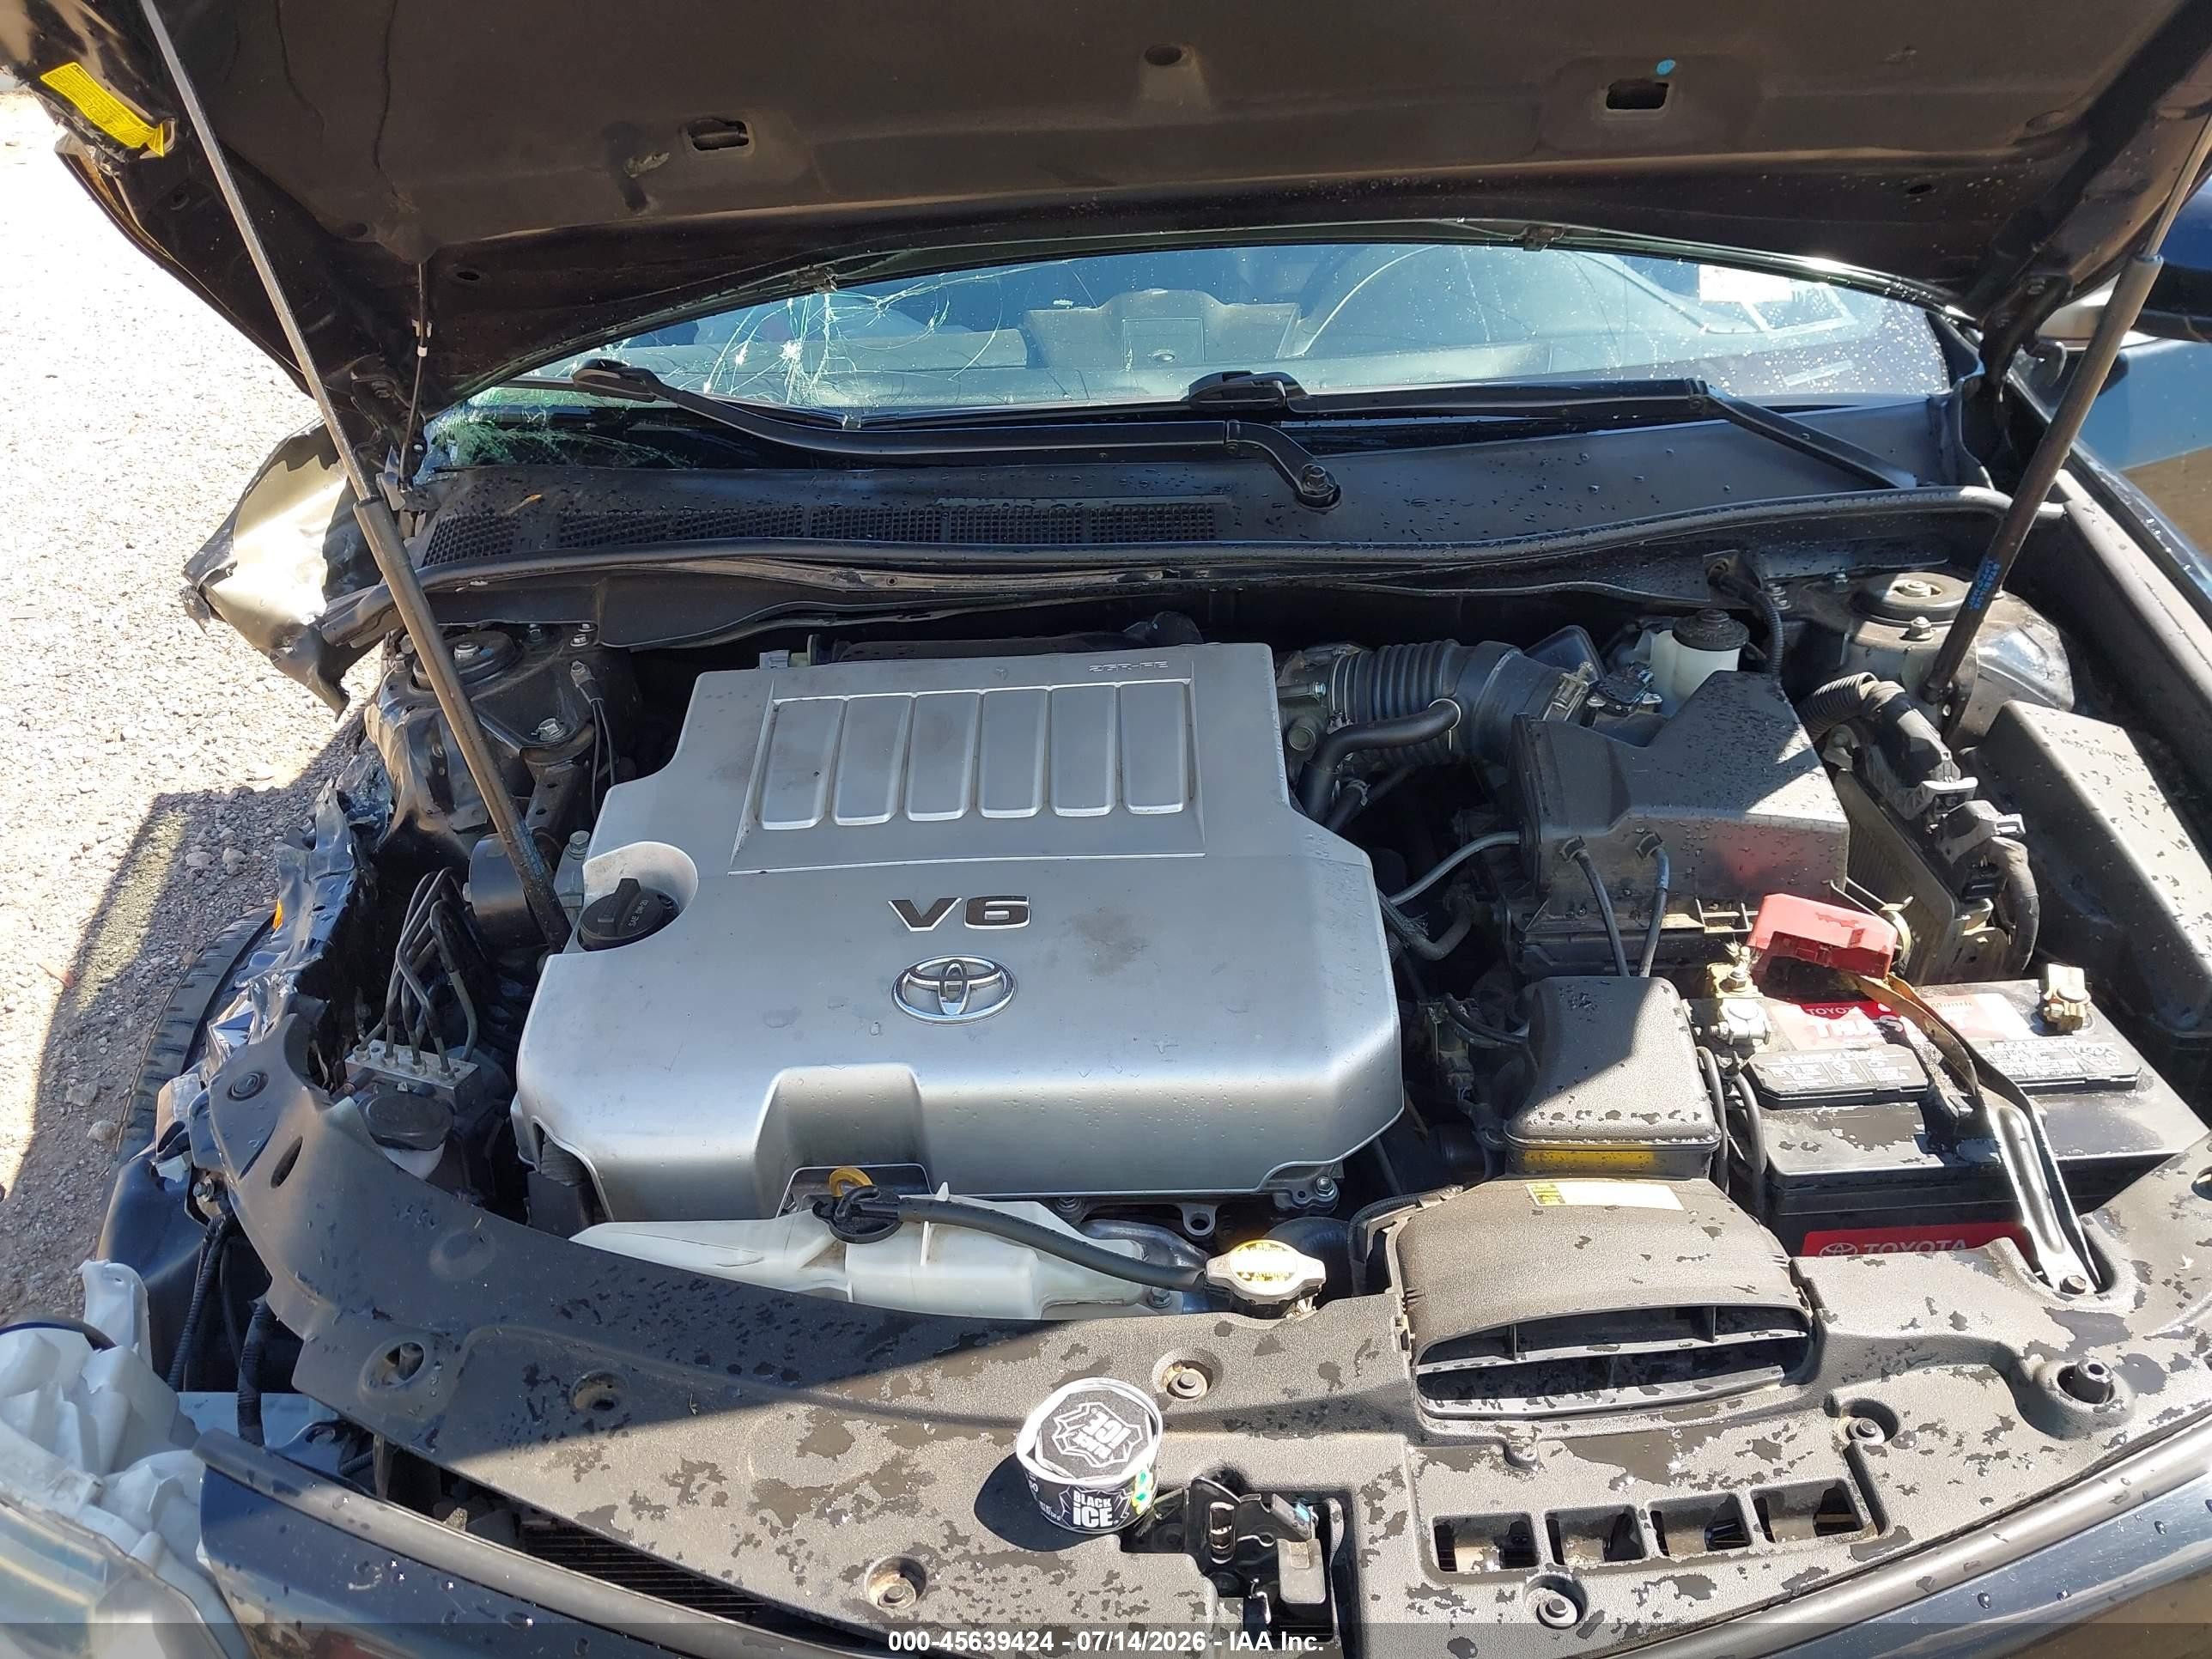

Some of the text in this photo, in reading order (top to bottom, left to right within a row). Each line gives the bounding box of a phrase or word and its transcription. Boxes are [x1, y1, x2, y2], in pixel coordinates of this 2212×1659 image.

[1088, 660, 1169, 672] 2GR-FE
[888, 895, 1030, 932] V6
[1806, 1006, 1857, 1016] TOYO
[1073, 1490, 1112, 1509] BLACK
